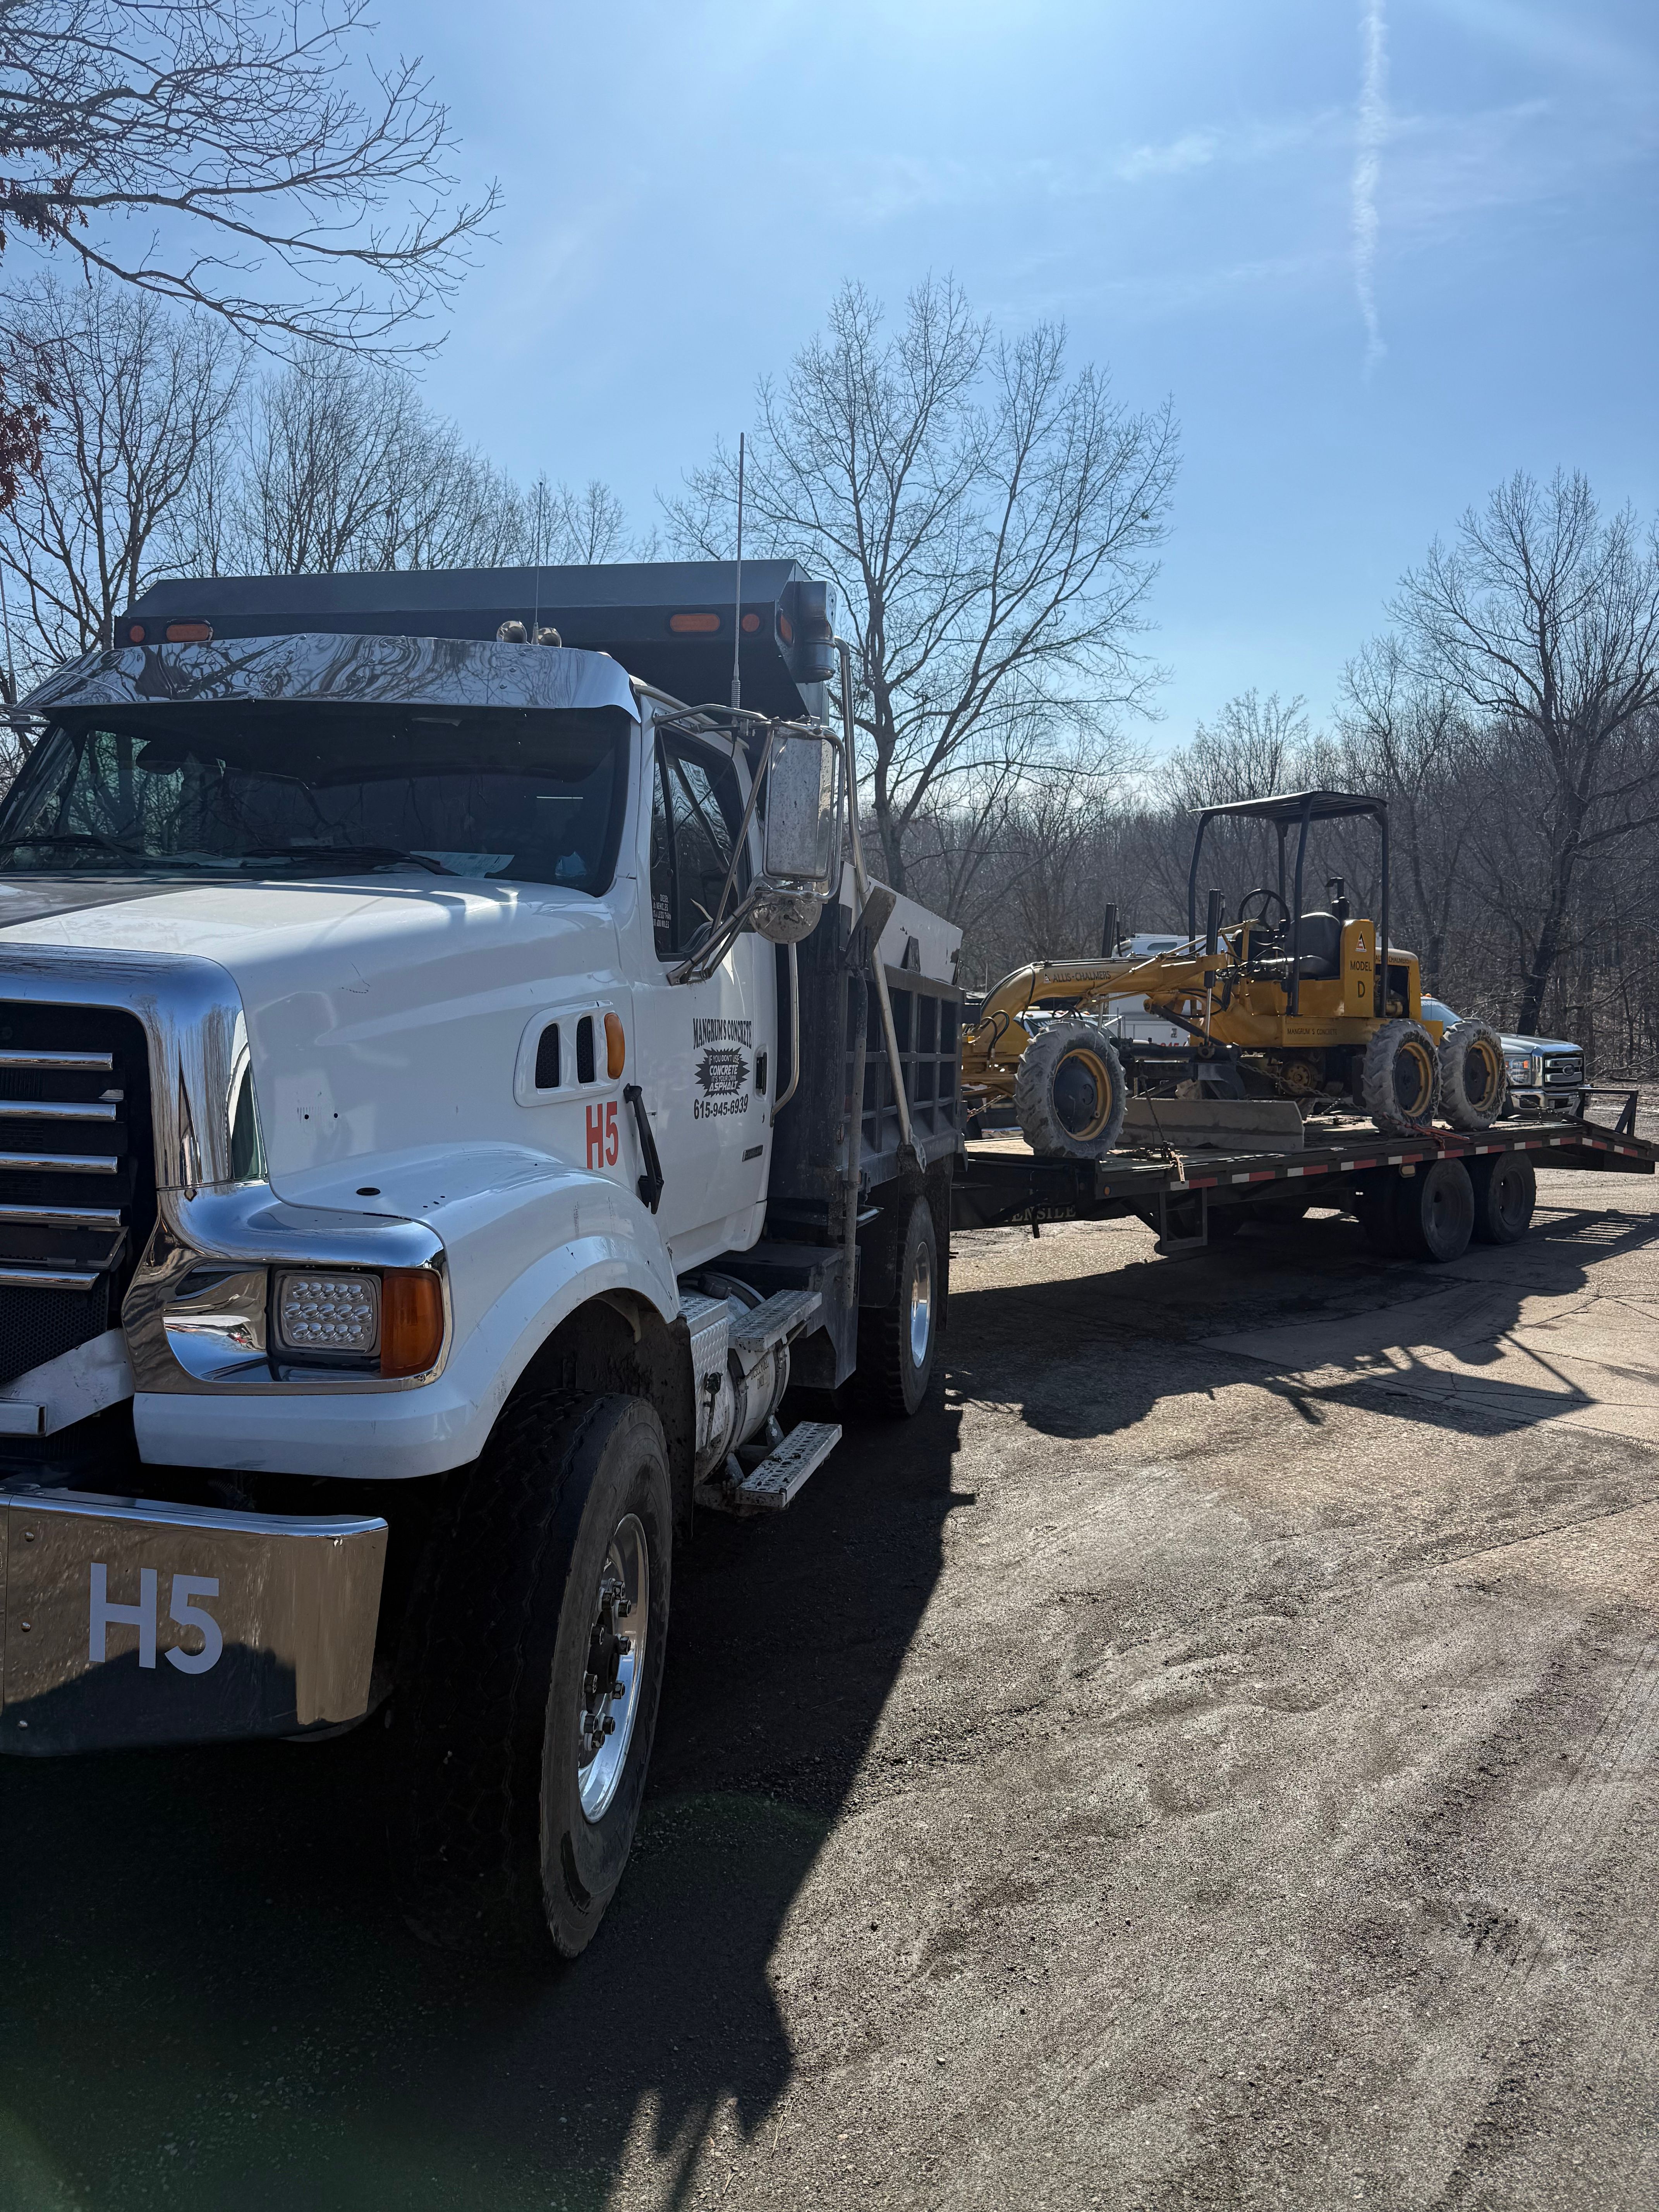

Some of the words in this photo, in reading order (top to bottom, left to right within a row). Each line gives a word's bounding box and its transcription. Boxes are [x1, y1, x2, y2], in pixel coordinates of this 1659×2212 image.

[1350, 960, 1372, 971] MODEL
[1053, 971, 1111, 983] ALLIS-CHALMERS
[1357, 981, 1365, 998] D
[693, 1018, 726, 1050] MANGRUM'S
[727, 1020, 752, 1049] CONCRETE
[708, 1055, 712, 1065] IF
[713, 1055, 721, 1063] YOU
[709, 1065, 738, 1076] CONCRETE
[709, 1081, 738, 1092] ASPHALT
[694, 1094, 748, 1120] 615-945-6939
[586, 1101, 619, 1170] H5
[1000, 1204, 1075, 1222] ENSILE
[89, 1562, 223, 1674] H5
